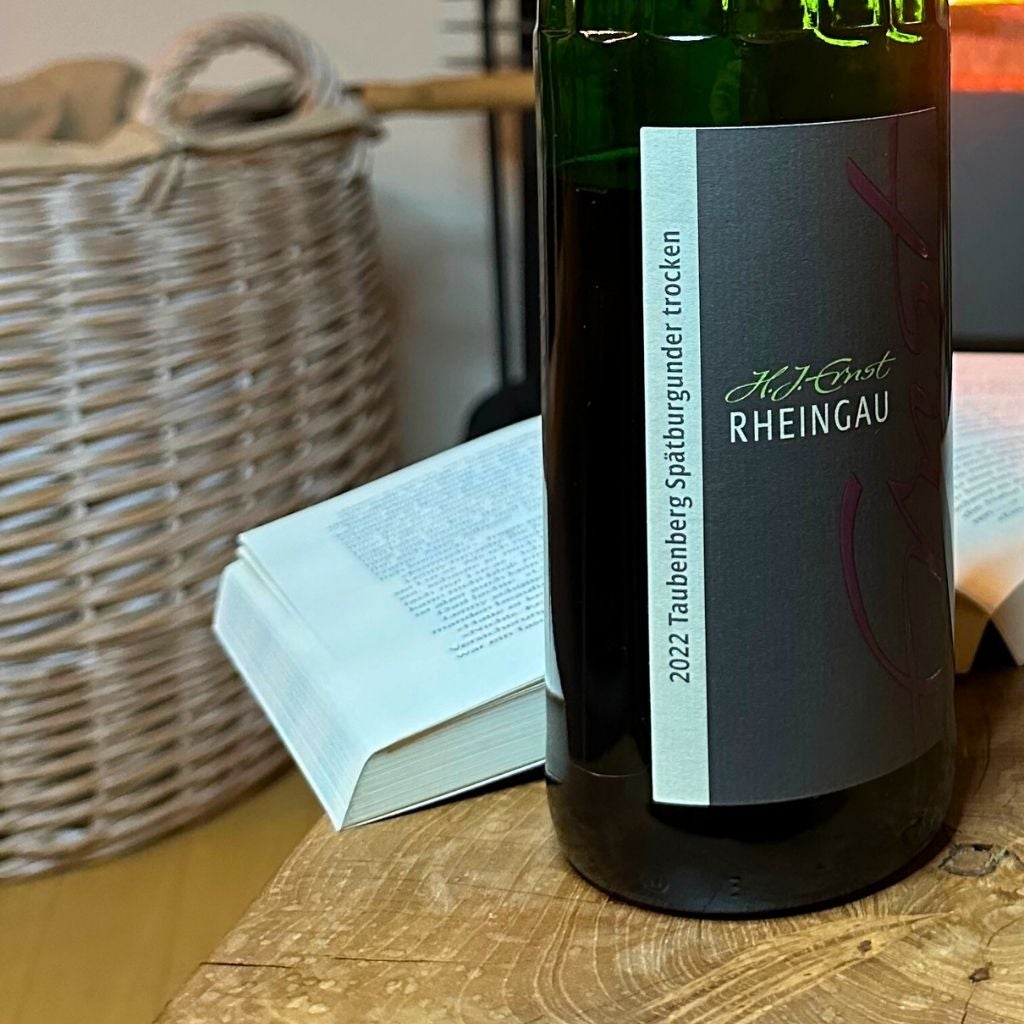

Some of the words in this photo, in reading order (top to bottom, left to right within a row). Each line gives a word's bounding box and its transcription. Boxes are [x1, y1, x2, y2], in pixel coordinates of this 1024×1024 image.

[658, 230, 682, 317] trocken
[660, 322, 693, 489] Spätburgunder
[729, 390, 890, 444] RHEINGAU
[665, 496, 693, 627] Taubenberg
[668, 633, 690, 684] 2022
